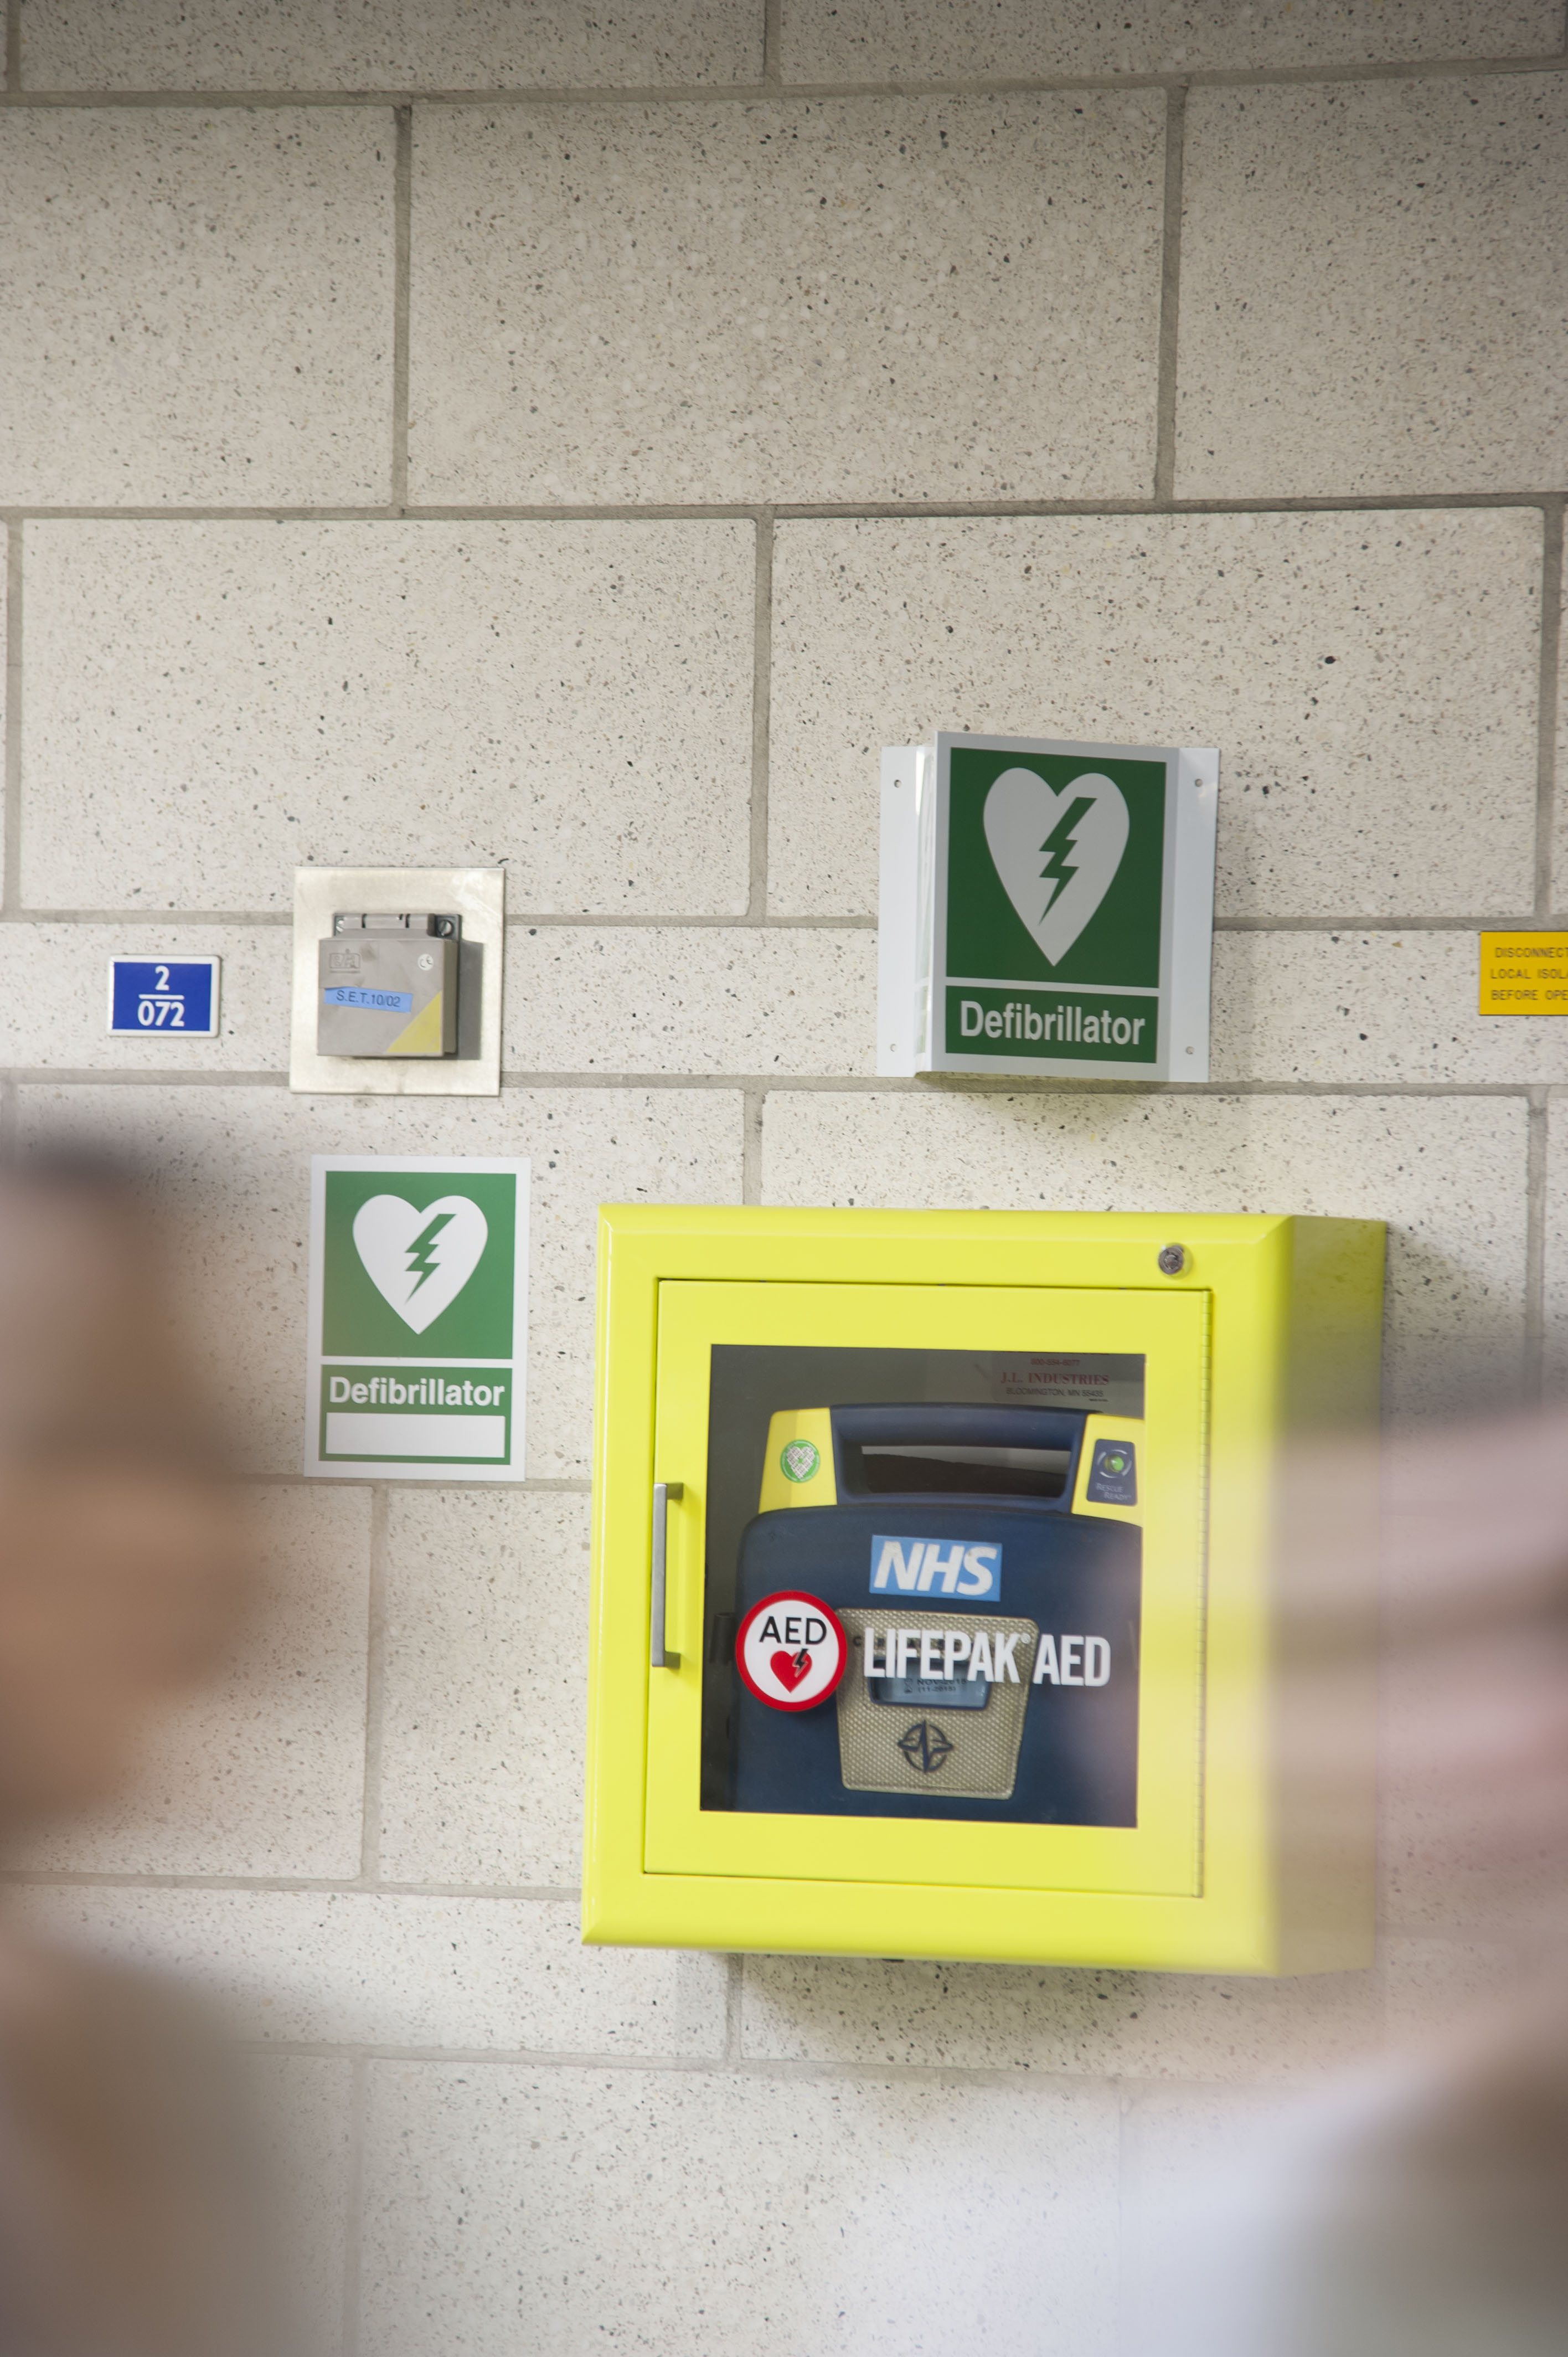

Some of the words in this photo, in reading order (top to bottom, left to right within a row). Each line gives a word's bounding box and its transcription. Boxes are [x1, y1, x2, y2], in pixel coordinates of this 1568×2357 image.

[154, 966, 169, 991] 2
[1490, 969, 1531, 979] LOCAL
[1537, 969, 1568, 979] ISOL
[1491, 990, 1539, 1000] BEFORE
[137, 1002, 185, 1027] 072
[960, 1000, 1145, 1045] Defibrillator
[329, 1376, 504, 1406] Defibrillator
[1001, 1372, 1023, 1384] J.L.
[1028, 1372, 1110, 1385] INDUSTRIES
[874, 1541, 997, 1596] NHS
[759, 1616, 827, 1645] AED
[1033, 1634, 1111, 1687] AED
